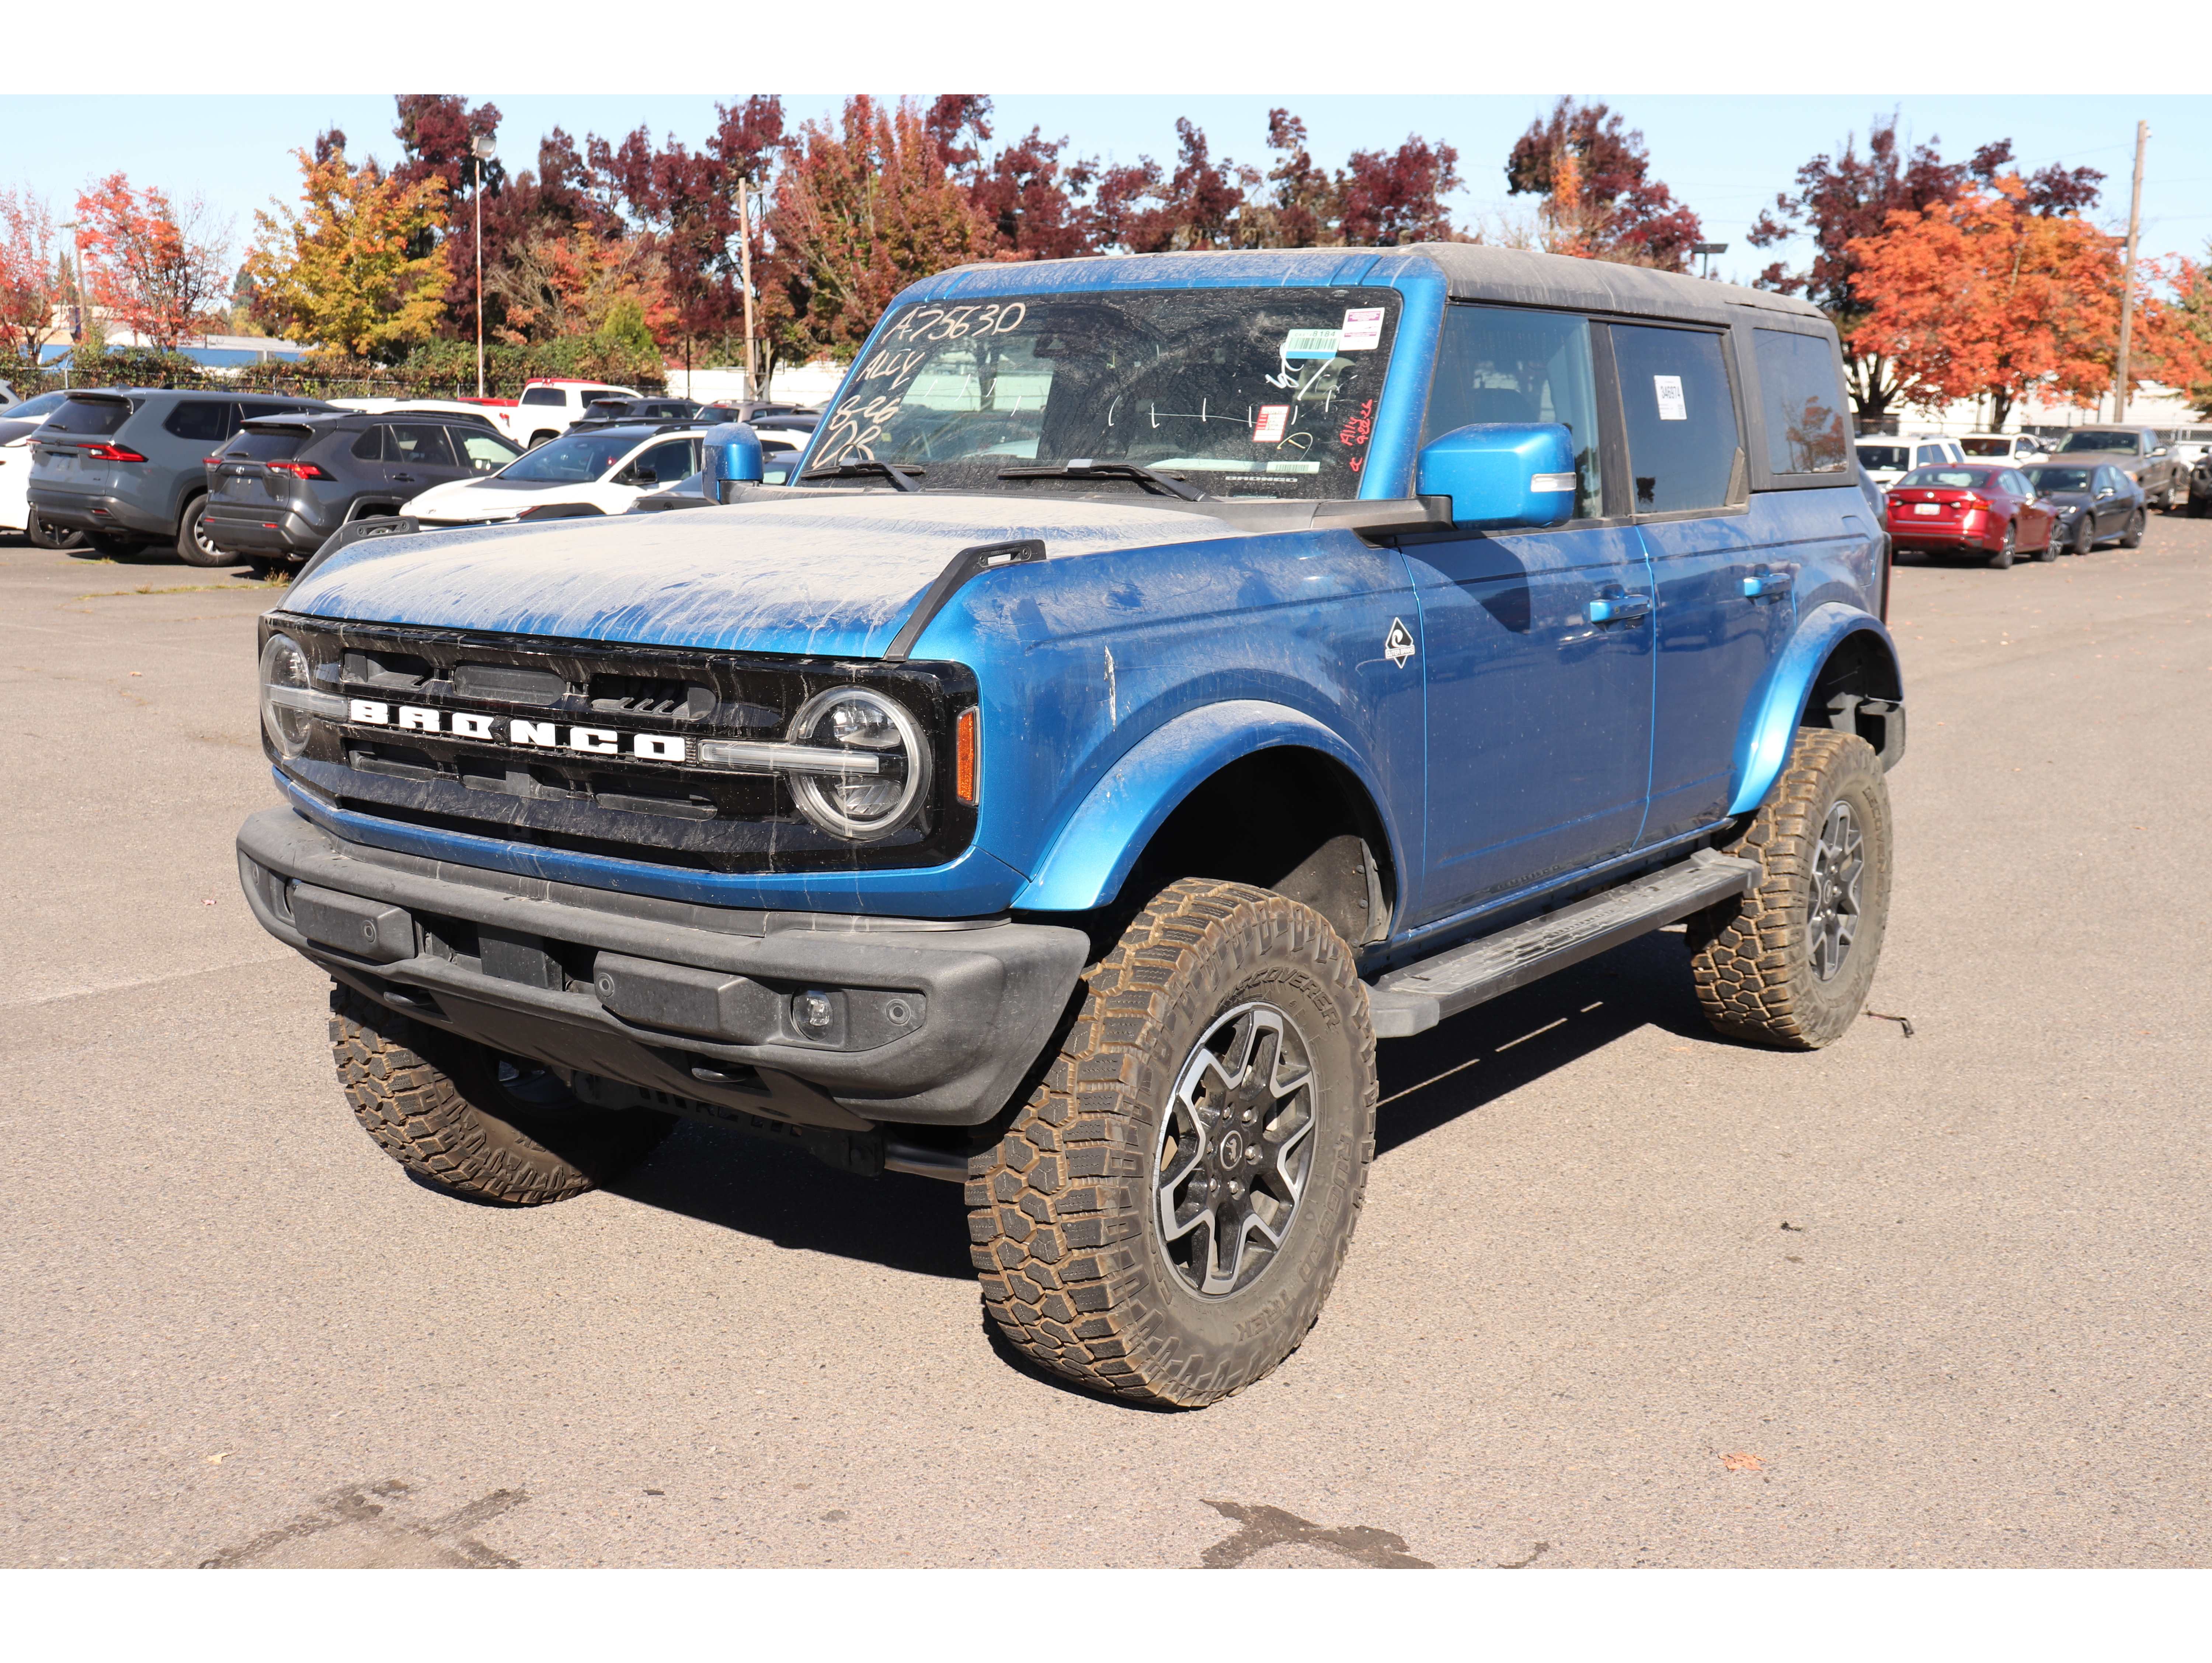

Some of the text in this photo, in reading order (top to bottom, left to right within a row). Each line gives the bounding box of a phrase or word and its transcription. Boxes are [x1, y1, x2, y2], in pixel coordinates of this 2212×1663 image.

[856, 349, 925, 391] ALLY
[1340, 417, 1362, 446] Ally
[350, 698, 685, 762] BRONCO
[1237, 1132, 1354, 1343] RUGGED TREK
